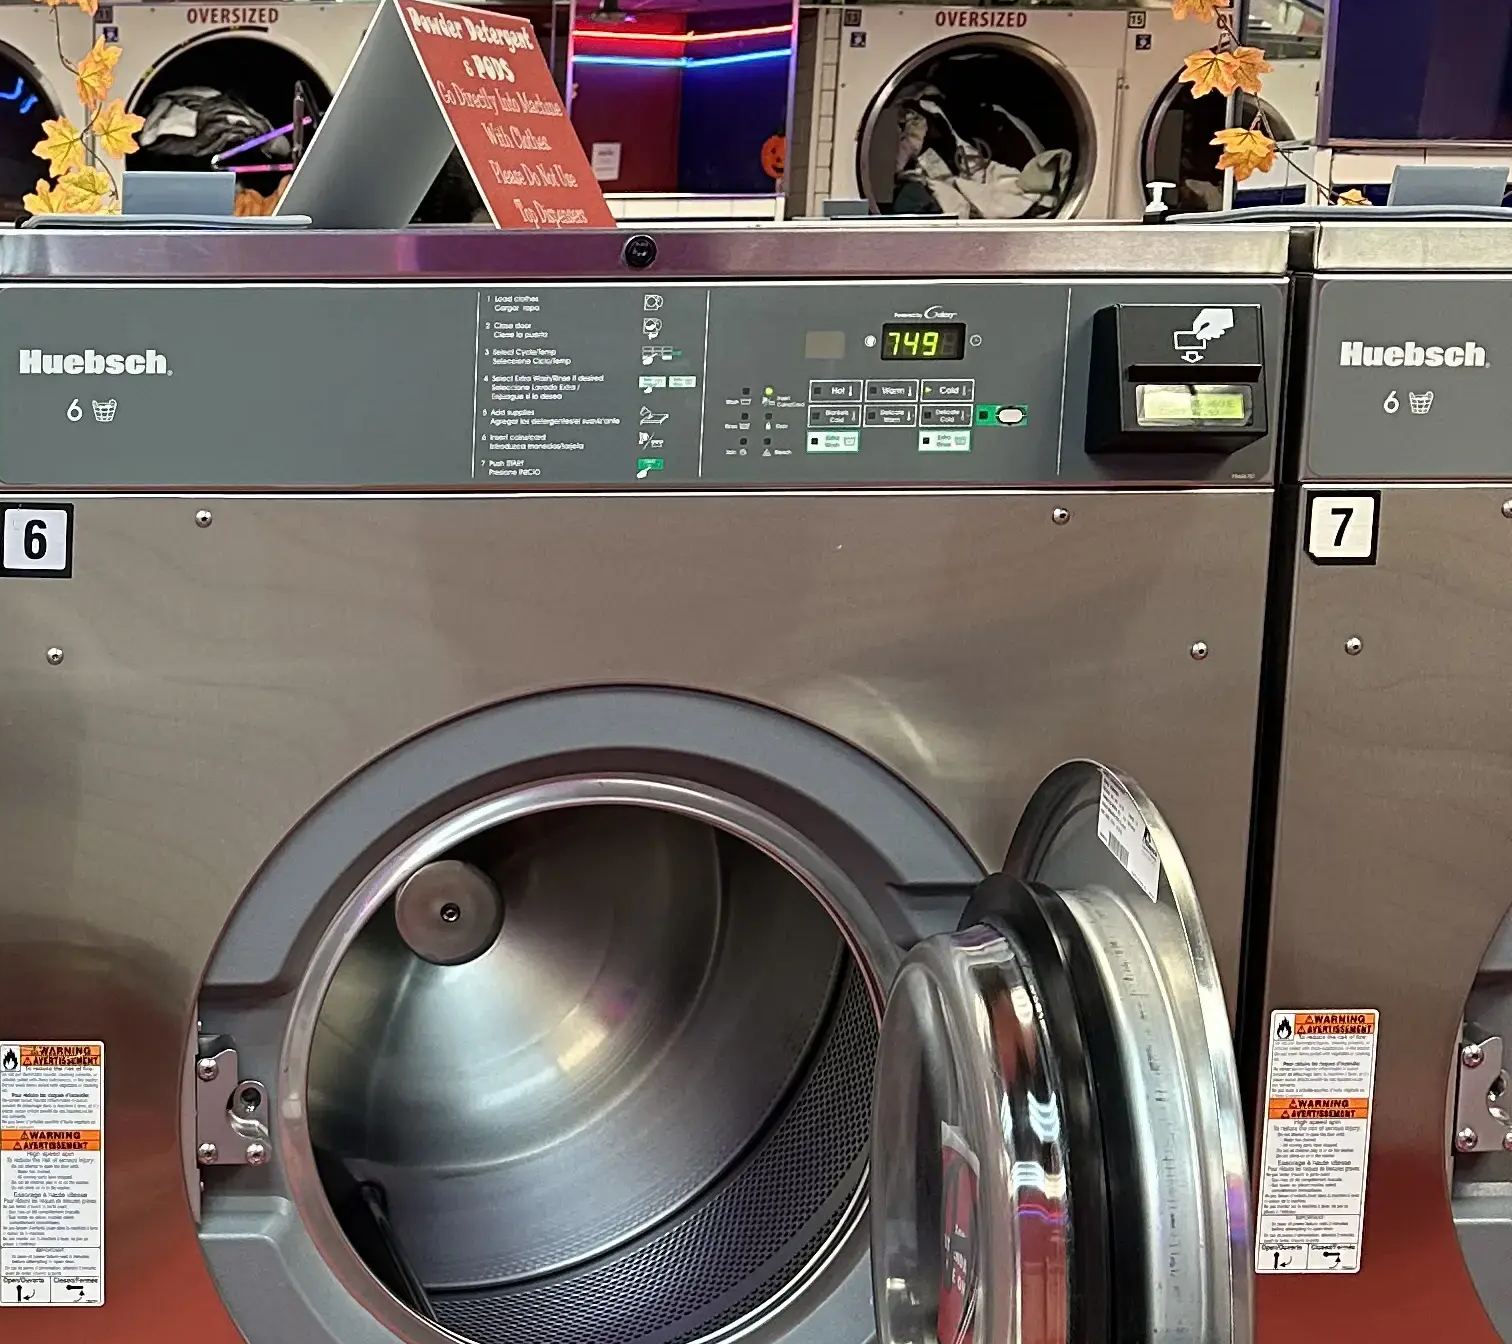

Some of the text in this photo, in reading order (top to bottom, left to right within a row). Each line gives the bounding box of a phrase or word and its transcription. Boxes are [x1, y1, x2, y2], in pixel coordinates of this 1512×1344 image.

[187, 8, 279, 24] OVERSIZED
[935, 12, 1027, 28] OVERSIZED
[406, 7, 534, 53] Powder Detergent
[472, 55, 516, 83] PODS
[437, 80, 563, 116] Go Directly Into Machine
[481, 123, 552, 151] With Clothes
[489, 160, 578, 188] Please Do Not Use
[513, 199, 540, 228] Top
[888, 332, 938, 356] 749
[1339, 341, 1487, 367] Huebsch
[19, 349, 167, 374] Huebsch
[831, 387, 845, 395] Hot
[939, 386, 959, 394] Cold
[1383, 391, 1400, 414] 6
[66, 398, 83, 422] 6
[23, 519, 48, 560] 6
[1330, 507, 1354, 548] 7
[1315, 1015, 1365, 1024] WARNING
[41, 1047, 91, 1055] WARNING
